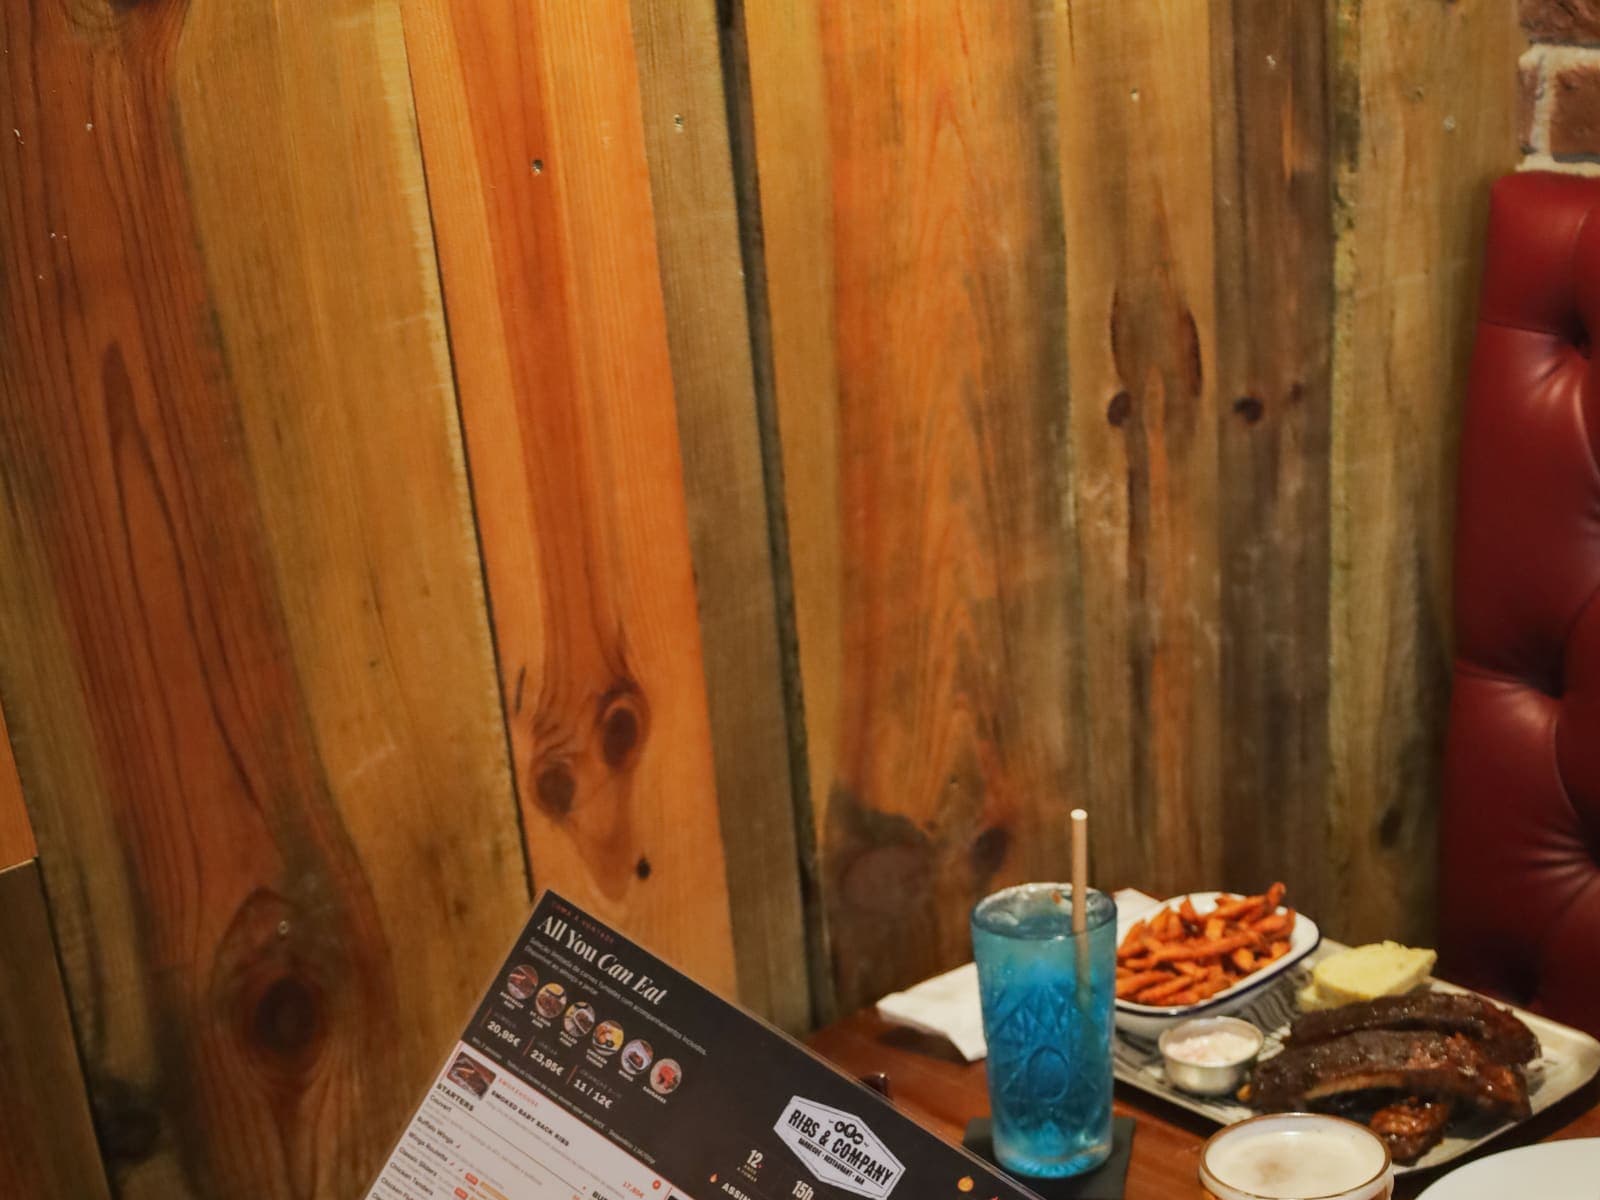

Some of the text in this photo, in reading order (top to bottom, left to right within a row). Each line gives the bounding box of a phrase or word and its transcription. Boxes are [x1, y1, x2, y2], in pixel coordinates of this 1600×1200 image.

[537, 915, 567, 940] All
[566, 929, 597, 962] You
[597, 953, 633, 984] Can
[632, 975, 667, 1004] Eat
[487, 1020, 520, 1046] 20,95€
[530, 1049, 563, 1075] 23,95€
[436, 1082, 473, 1111] STARTERS
[573, 1079, 586, 1091] 11
[592, 1092, 612, 1108] 12€
[491, 1090, 517, 1110] SMOKED
[517, 1108, 535, 1121] BABY
[535, 1120, 552, 1134] BACK
[554, 1133, 569, 1146] RIBS
[788, 1109, 893, 1185] RIBS & COMPANY
[797, 1137, 864, 1184] BARBECUE RESTAURANT BAR
